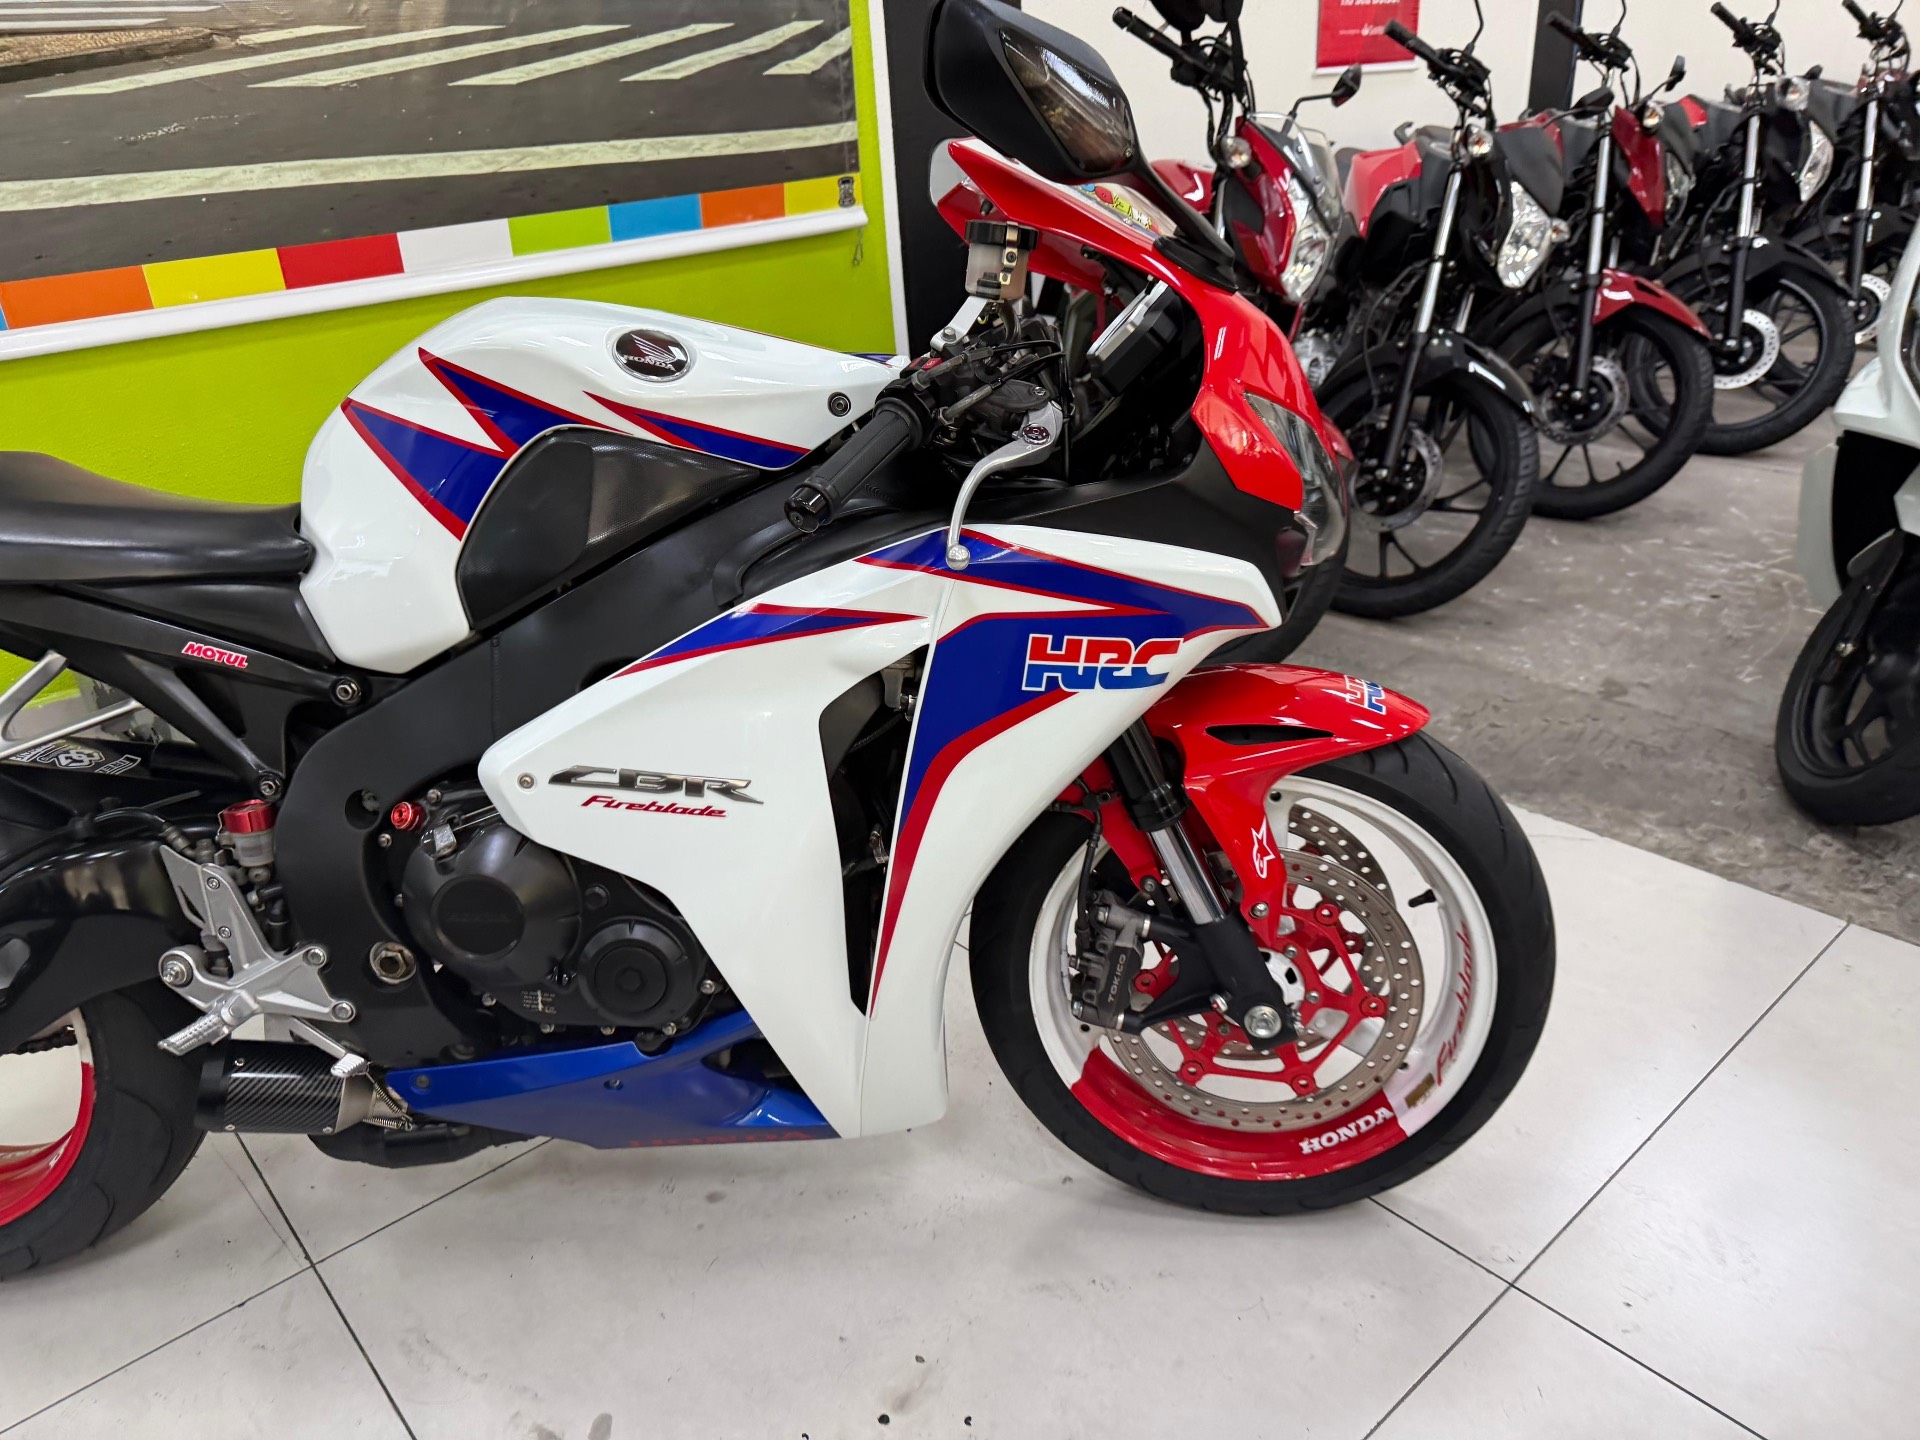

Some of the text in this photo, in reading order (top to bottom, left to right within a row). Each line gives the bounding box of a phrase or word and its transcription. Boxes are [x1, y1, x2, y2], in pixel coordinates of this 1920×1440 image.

[623, 354, 677, 372] HONDA
[181, 641, 249, 669] MOTUL
[1021, 633, 1185, 692] HRC
[547, 764, 765, 805] CBR
[580, 794, 727, 818] Fireblade
[1107, 953, 1127, 1004] TOKICO
[1299, 1106, 1395, 1155] HONDA
